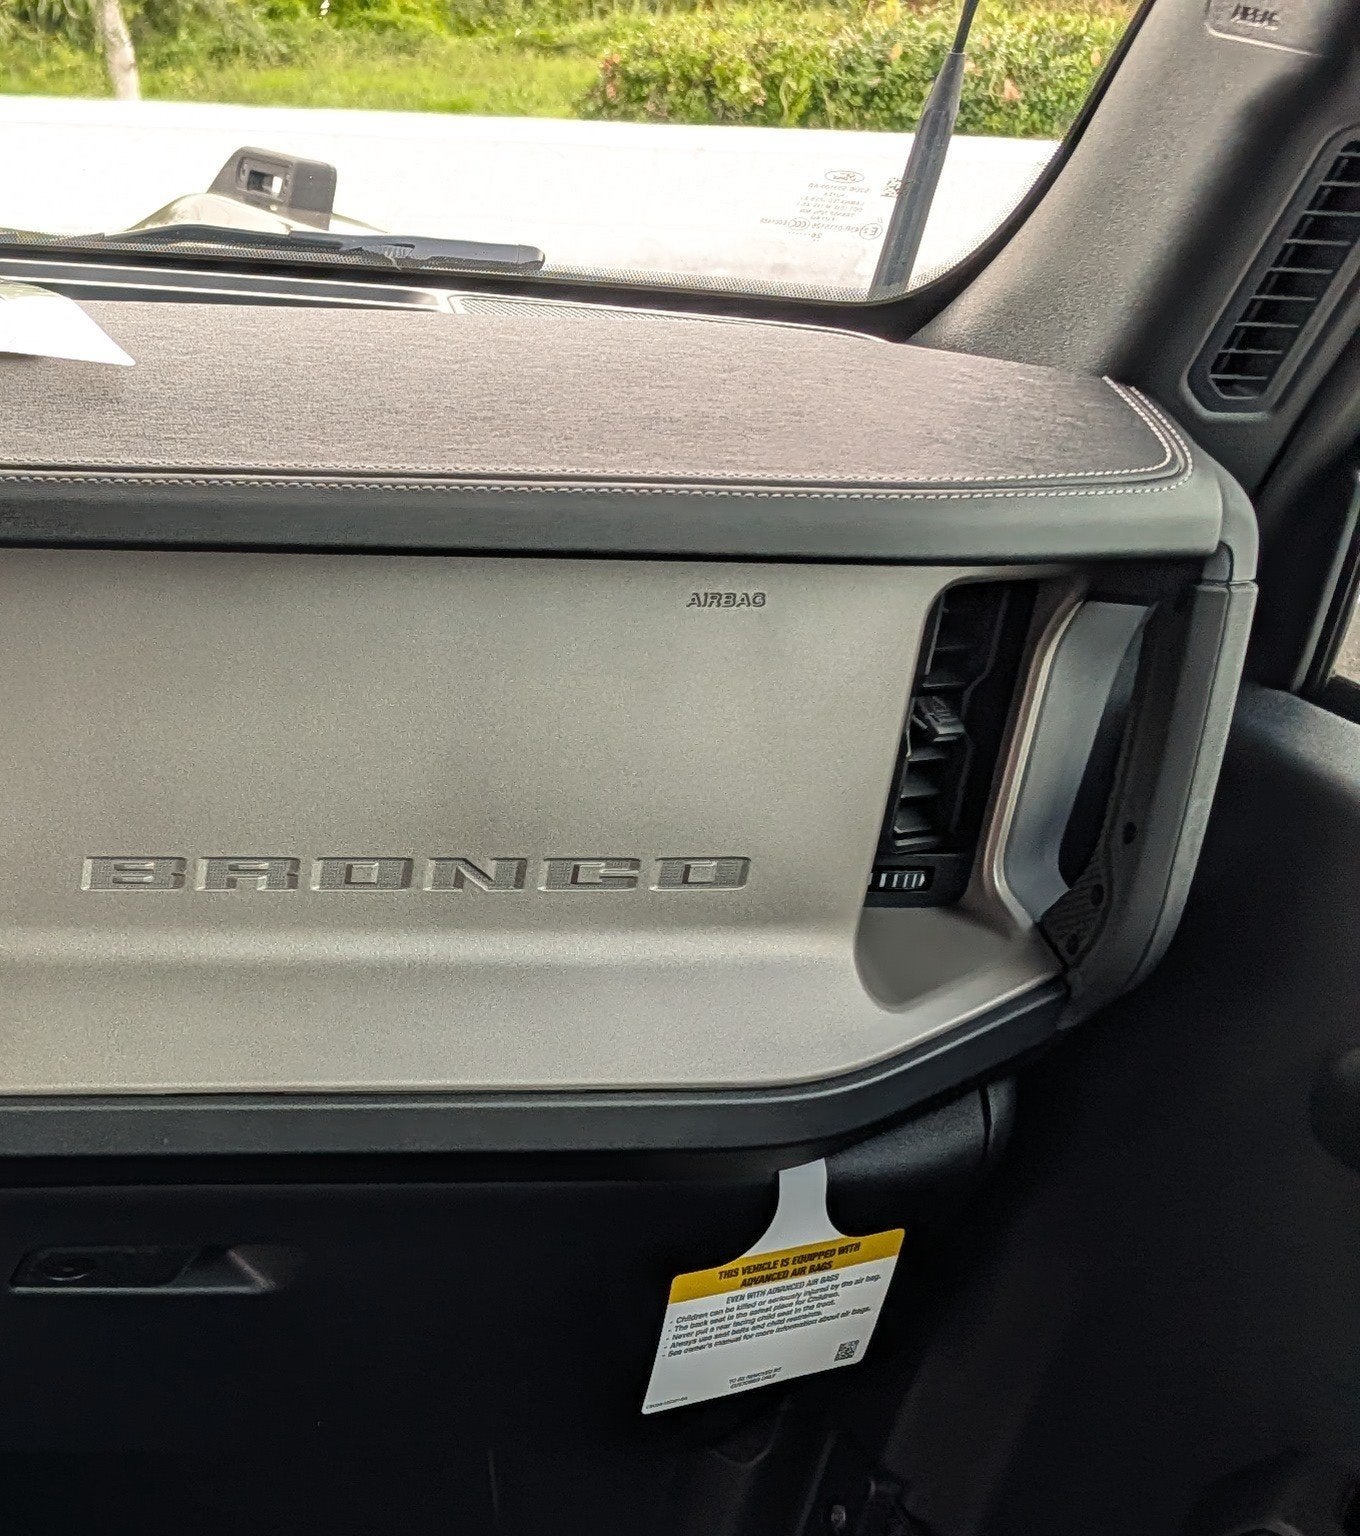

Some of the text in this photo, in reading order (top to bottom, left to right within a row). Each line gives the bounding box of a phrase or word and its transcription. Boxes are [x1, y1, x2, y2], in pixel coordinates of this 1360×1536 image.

[685, 592, 767, 608] AIRBAG
[80, 855, 753, 892] BRONCO
[717, 1241, 861, 1281] THIS VEHICLE IS EQUIPPED WITH
[739, 1260, 833, 1288] ADVANCED AIR BAGS
[805, 1277, 819, 1286] AIR
